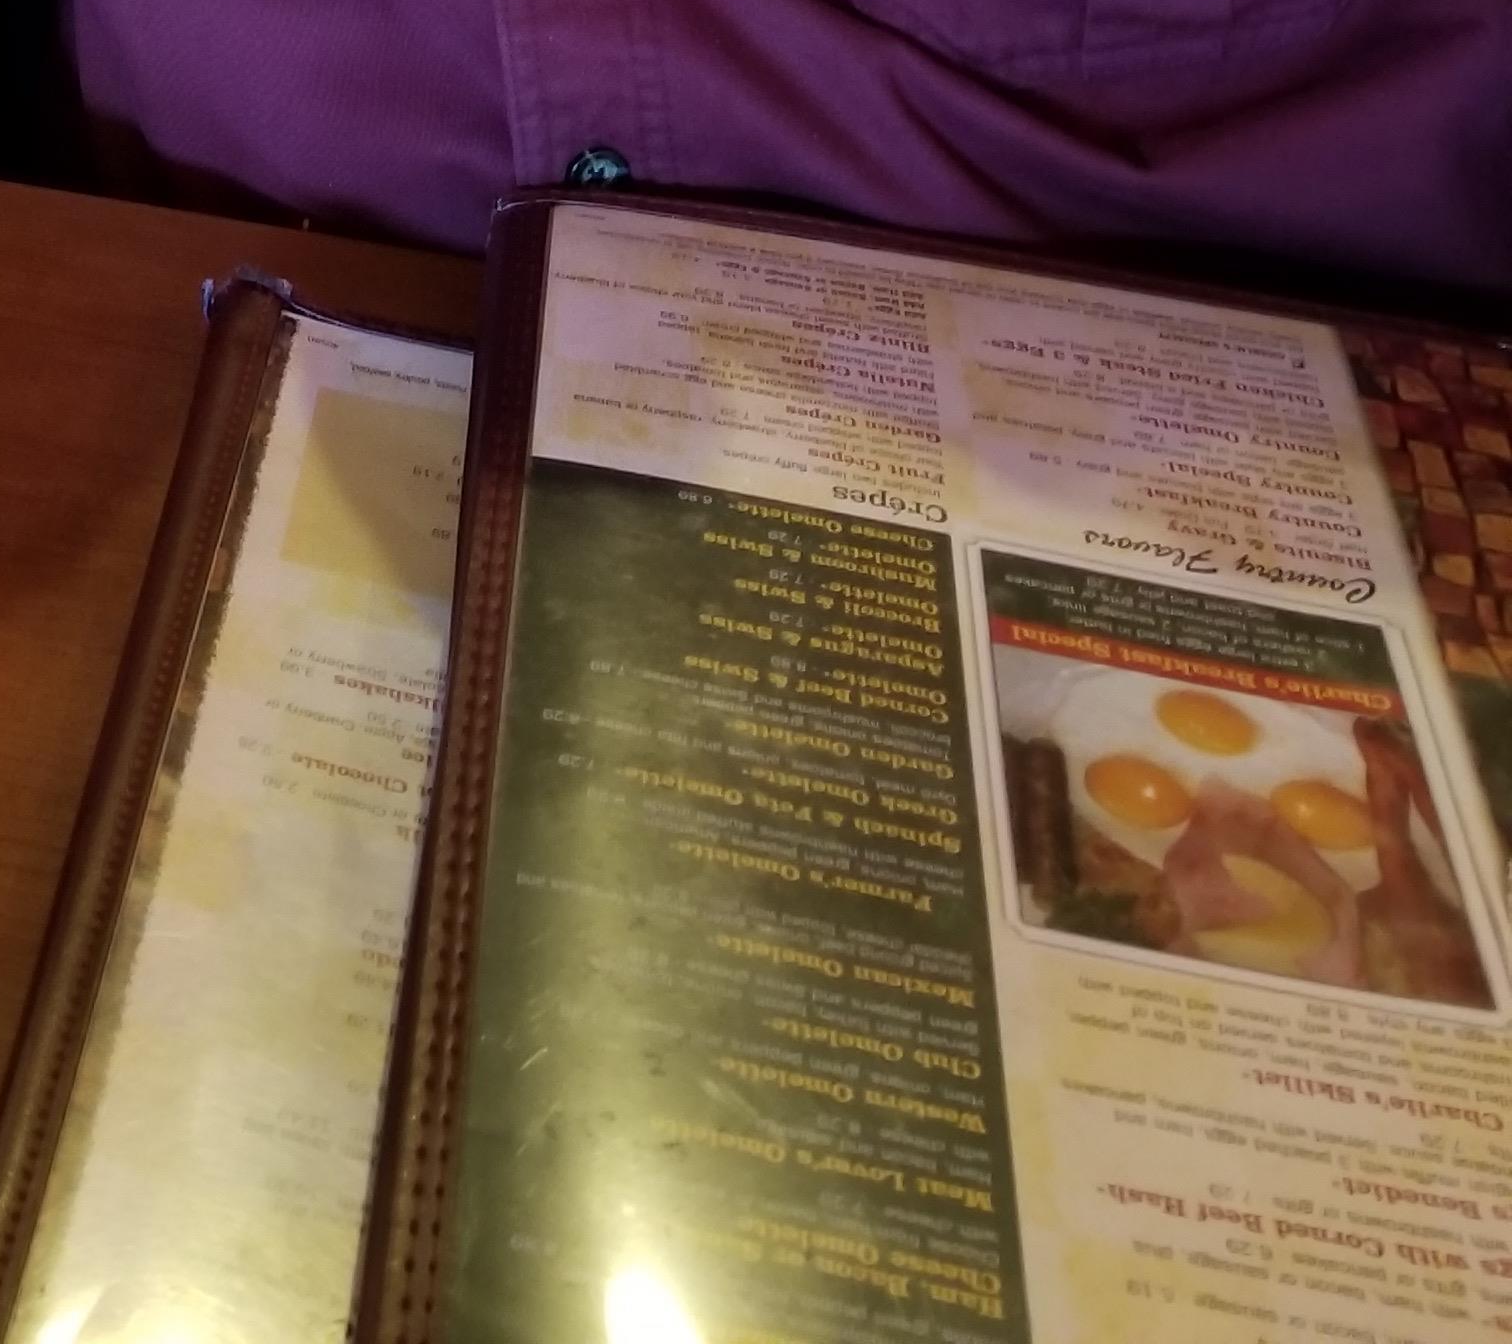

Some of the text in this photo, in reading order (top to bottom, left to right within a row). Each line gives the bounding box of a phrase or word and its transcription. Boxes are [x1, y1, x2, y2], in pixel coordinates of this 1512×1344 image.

[868, 333, 931, 355] Blintz
[1071, 352, 1091, 366] &
[856, 366, 936, 395] Nutella
[1097, 356, 1163, 380] Steak
[1168, 368, 1228, 392] Fried
[1234, 382, 1325, 409] Chicken
[865, 418, 942, 445] Garden
[1249, 434, 1342, 463] Country
[807, 445, 945, 487] Fruit Crépes
[830, 483, 949, 524] Crépes
[1259, 477, 1354, 506] Country
[849, 522, 934, 552] Cheese
[1268, 508, 1363, 539] Country
[700, 529, 938, 592] Mushroom & Swiss
[1167, 518, 1372, 571] Biscuits & Gravy
[1083, 528, 1376, 604] Country Flavors
[731, 576, 942, 634] Broccoli & Swiss
[286, 647, 304, 659] or
[696, 612, 945, 680] Asparagus & Swiss
[307, 650, 388, 683] Strawberry
[1011, 624, 1392, 711] Charlie's Breakfast Special
[683, 654, 951, 725] Corned Beef & Swiss
[283, 701, 355, 733] Cranberry
[291, 751, 409, 795] Chocolate
[859, 746, 954, 782] Garden
[752, 791, 813, 822] Feta
[821, 808, 845, 828] &
[879, 793, 959, 826] Greek
[852, 815, 962, 855] Spinach
[809, 869, 933, 913] Farmer's
[853, 964, 976, 1010] Mexican
[913, 1047, 982, 1080] Club
[864, 1090, 987, 1134] Western
[1364, 1091, 1504, 1132] Charlie's
[796, 1148, 906, 1192] Lover's
[915, 1176, 993, 1213] Meat
[1196, 1204, 1265, 1235] Beef
[1274, 1220, 1386, 1258] Corned
[1395, 1243, 1470, 1270] with
[814, 1254, 910, 1299] Bacon
[888, 1250, 1002, 1296] Cheese
[919, 1279, 1004, 1320] Ham,
